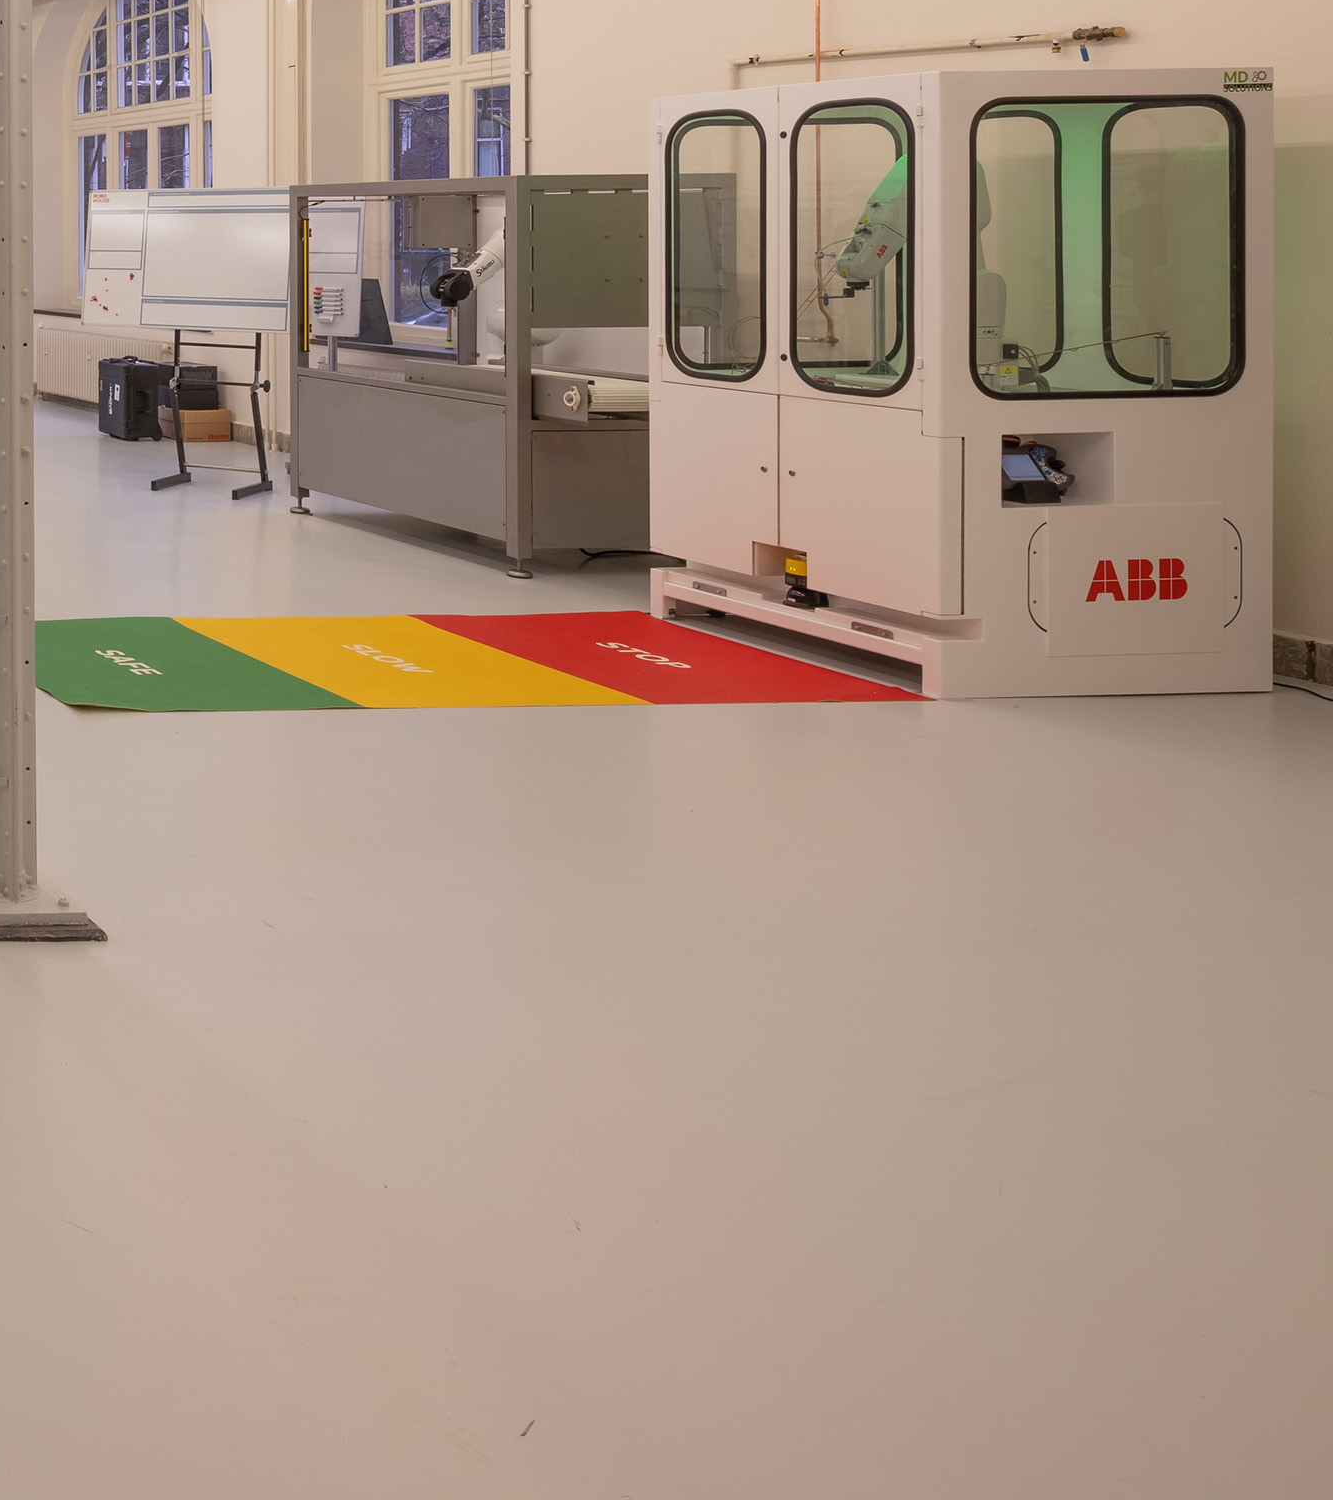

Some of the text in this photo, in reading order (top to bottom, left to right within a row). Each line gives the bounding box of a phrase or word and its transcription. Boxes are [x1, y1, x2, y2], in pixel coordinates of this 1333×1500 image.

[1223, 71, 1248, 83] MD
[1223, 84, 1273, 92] SOLUTIONS
[877, 244, 888, 258] ABB
[1085, 558, 1188, 602] ABB
[95, 650, 163, 675] SAFE
[342, 644, 435, 673] SLOW
[595, 642, 691, 668] STOP
